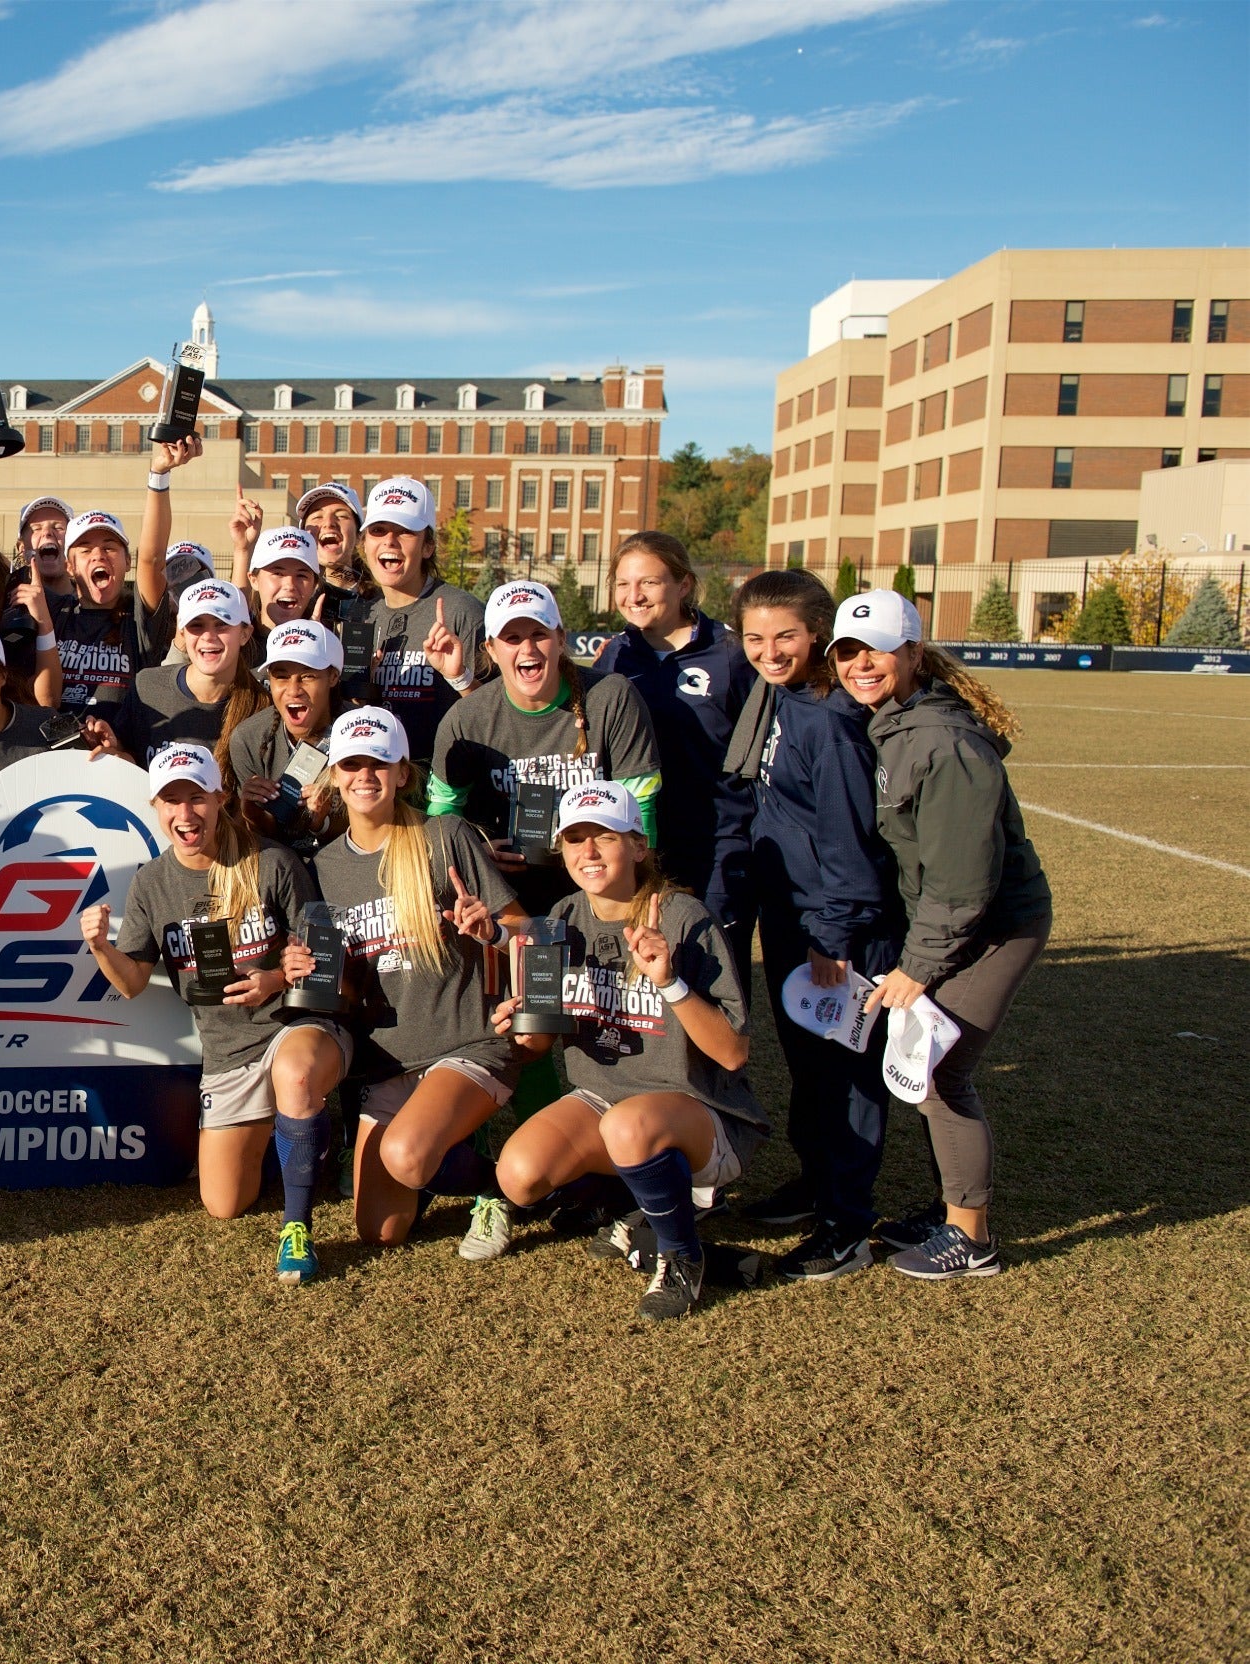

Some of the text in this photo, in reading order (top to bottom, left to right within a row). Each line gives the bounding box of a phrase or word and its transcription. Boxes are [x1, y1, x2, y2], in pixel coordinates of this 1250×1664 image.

[184, 344, 200, 354] BIG
[180, 349, 203, 360] EAST
[852, 604, 872, 618] G
[402, 650, 427, 666] EAST
[962, 652, 981, 660] 2013
[989, 652, 1008, 661] 2012
[1202, 655, 1222, 663] 2012
[83, 674, 121, 684] SOCCER
[375, 665, 434, 691] mpions
[388, 690, 421, 698] SOCCER
[567, 752, 598, 770] EAST
[192, 905, 222, 914] EAST
[106, 994, 122, 1002] TM
[614, 1017, 654, 1030] SOCCER
[885, 1064, 922, 1092] PIONS
